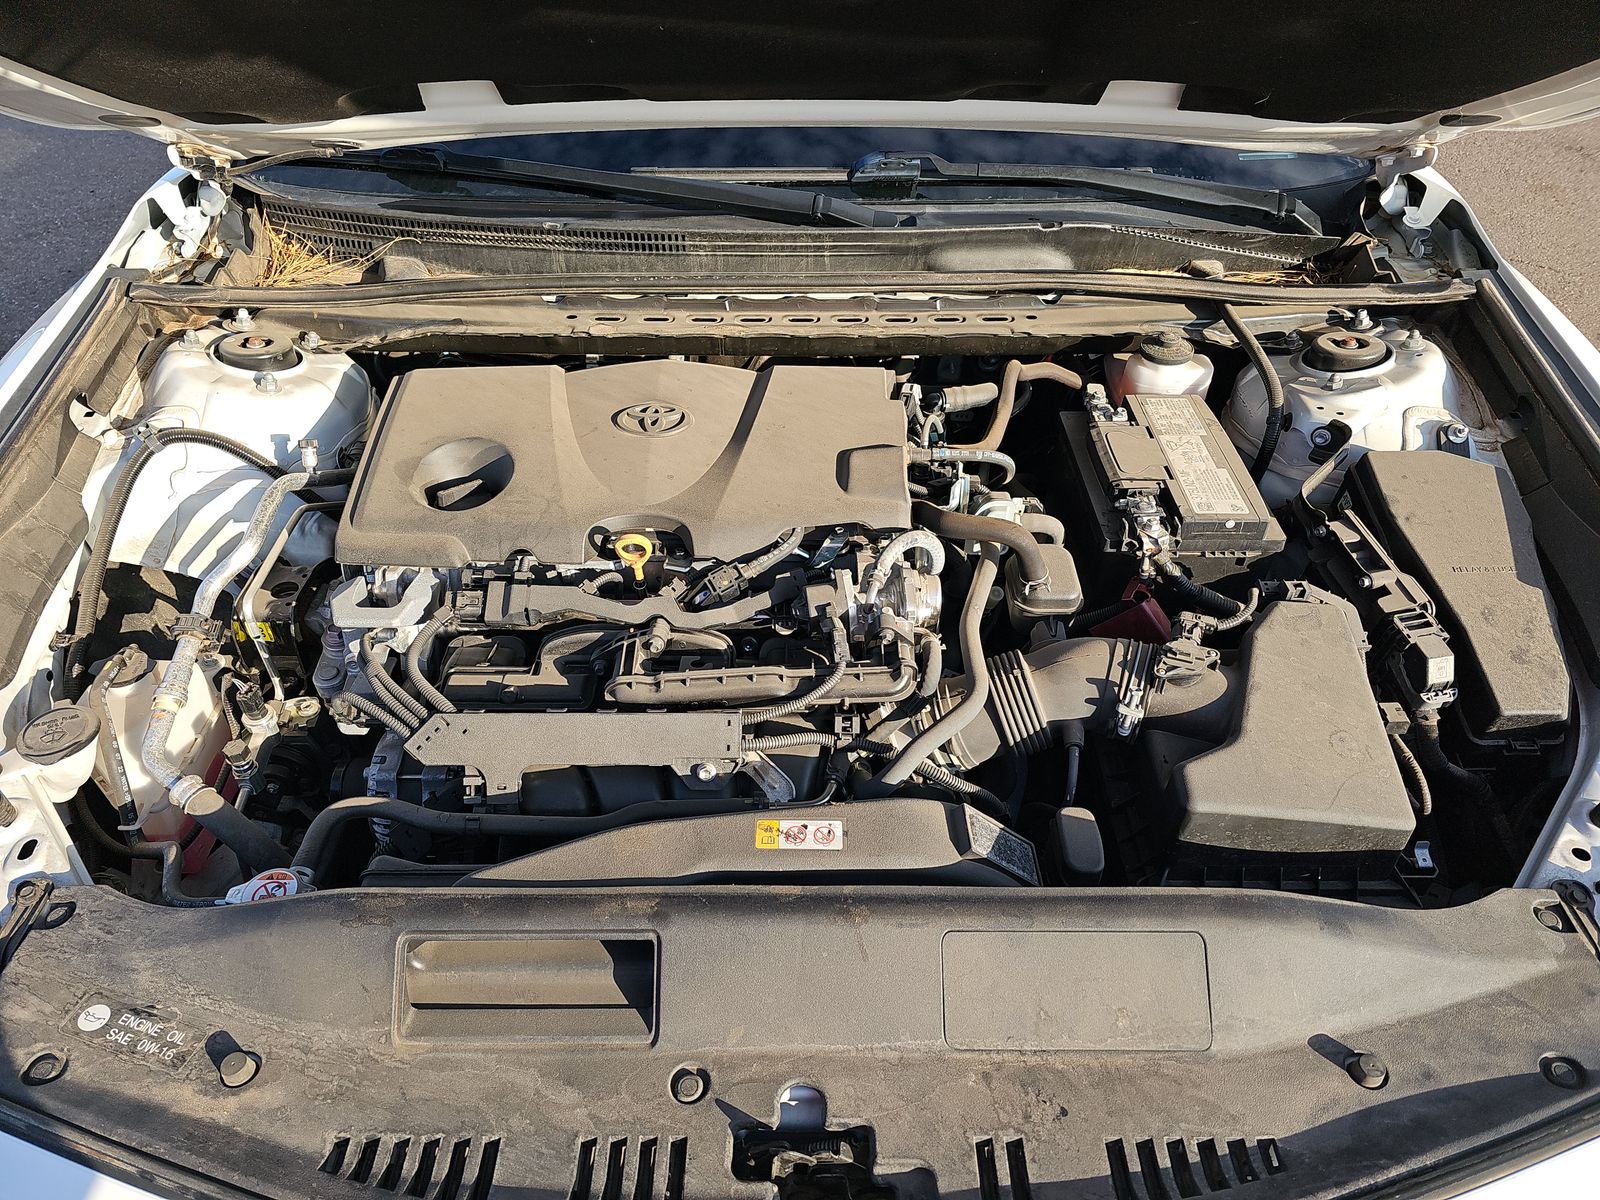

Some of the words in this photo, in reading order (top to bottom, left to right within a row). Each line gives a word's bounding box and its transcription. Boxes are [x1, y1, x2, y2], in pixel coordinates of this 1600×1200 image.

[106, 1028, 134, 1046] SAE
[137, 1039, 177, 1060] 0W-16
[118, 1013, 164, 1037] ENGINE
[166, 1030, 186, 1046] OIL
